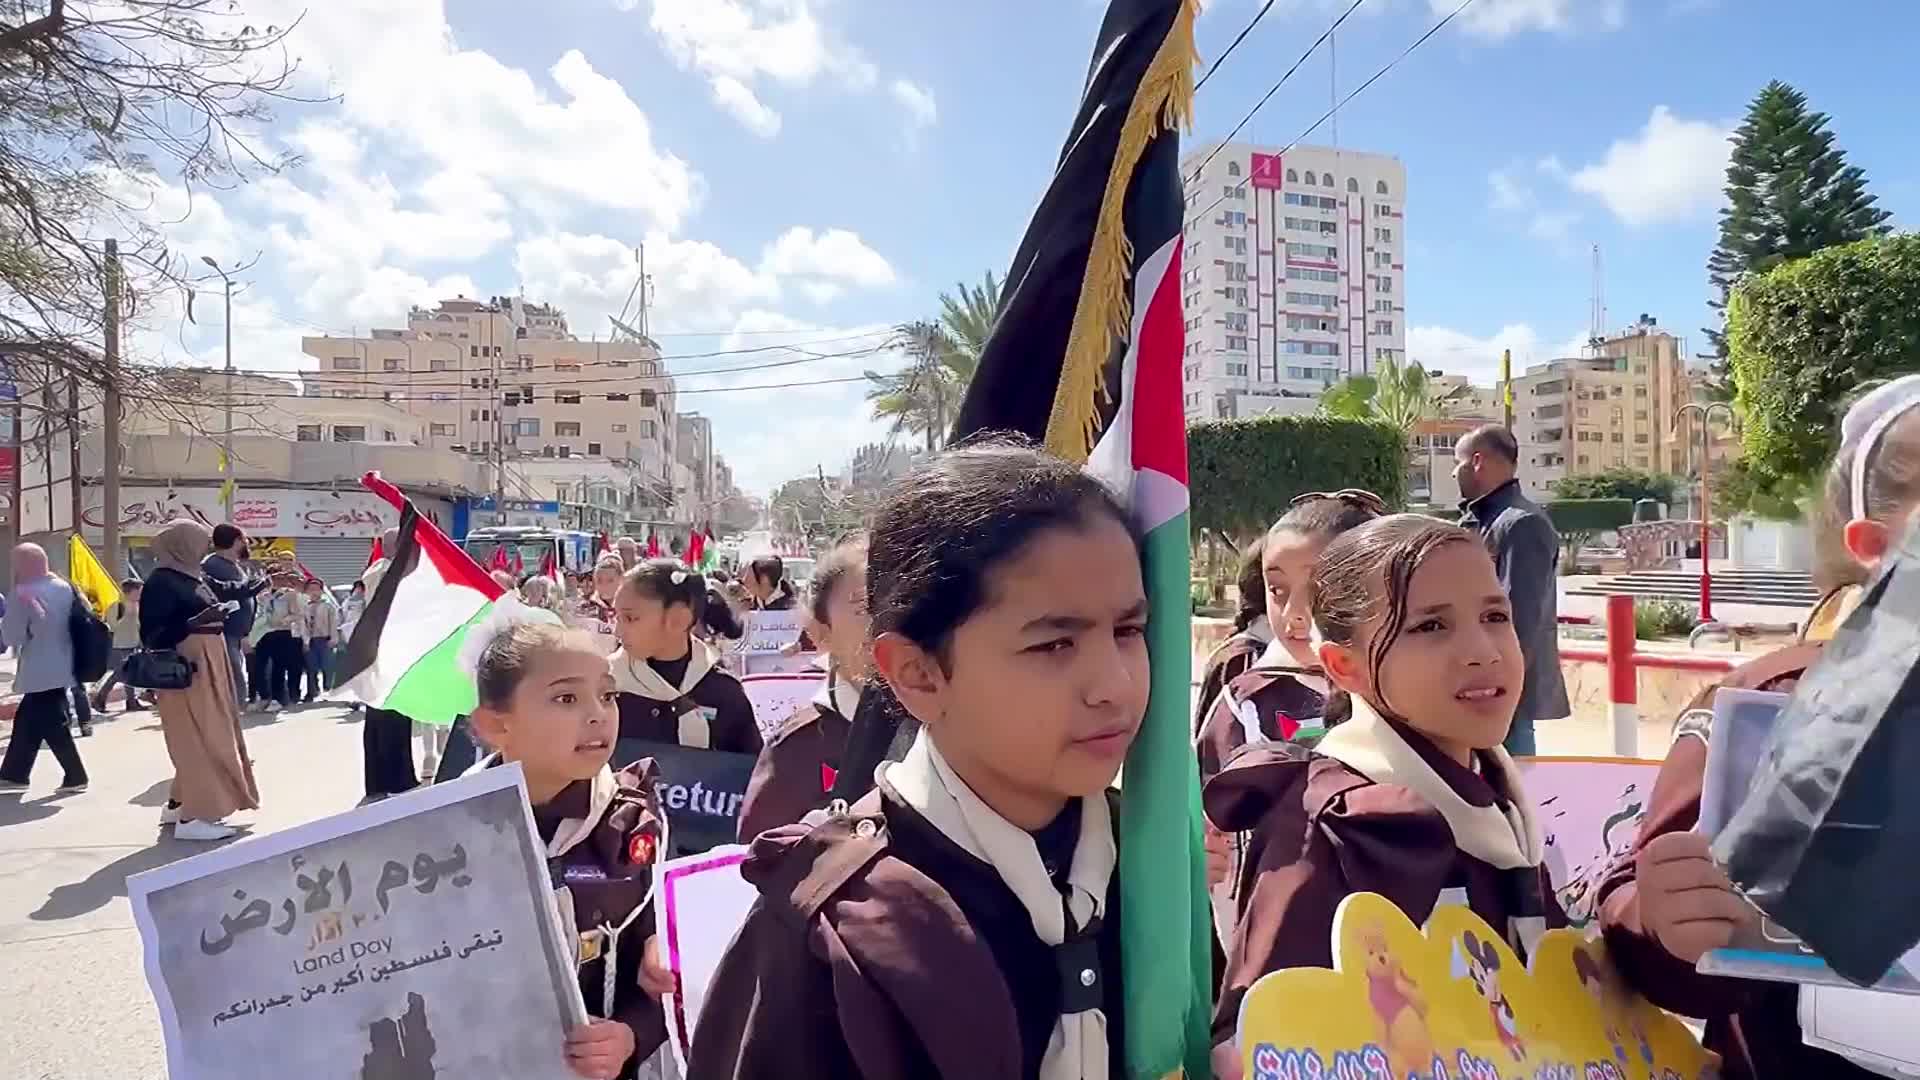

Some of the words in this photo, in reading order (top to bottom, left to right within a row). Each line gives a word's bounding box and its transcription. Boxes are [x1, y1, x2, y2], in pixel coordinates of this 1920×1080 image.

[375, 843, 473, 915] يوم
[200, 855, 353, 956] الأرض
[293, 946, 345, 975] Land
[350, 936, 393, 959] Day
[370, 940, 452, 983] فلسطين
[457, 929, 504, 960] تبقى
[300, 984, 326, 1001] من
[332, 963, 365, 994] أكبر
[212, 993, 294, 1028] جدرانكم
